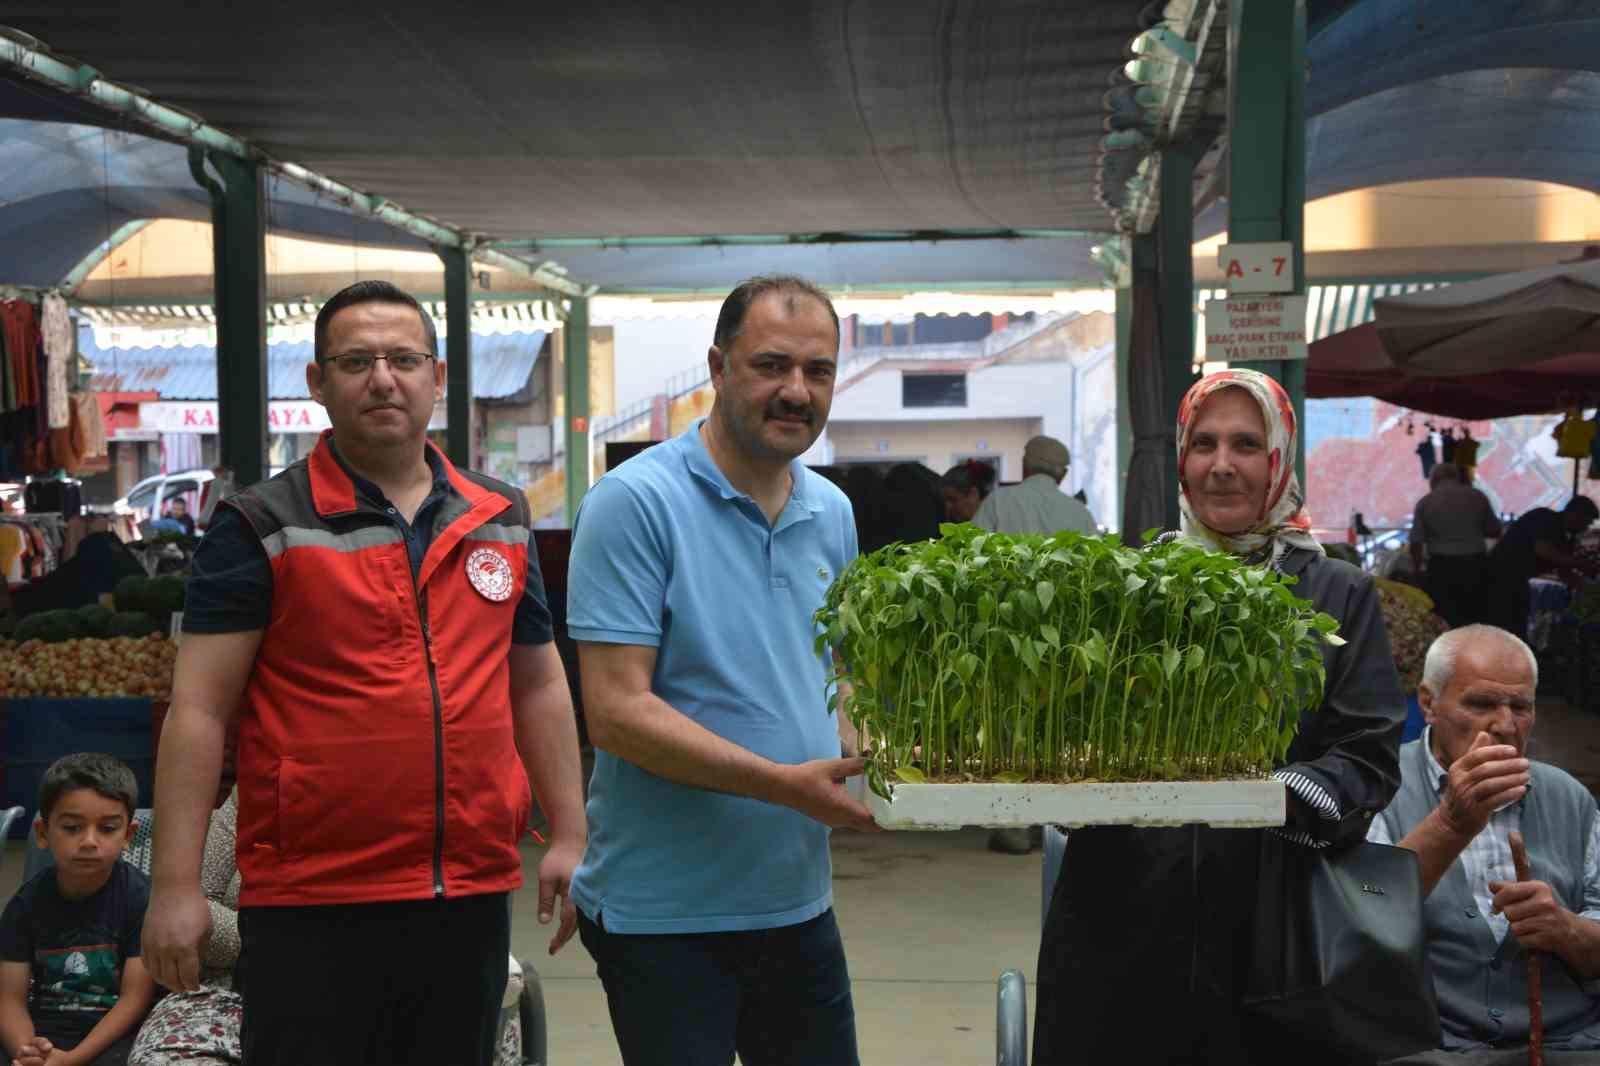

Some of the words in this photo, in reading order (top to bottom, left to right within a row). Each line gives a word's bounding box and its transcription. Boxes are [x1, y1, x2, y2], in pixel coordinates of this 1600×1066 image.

[1226, 258, 1244, 278] A
[1272, 256, 1287, 277] 7
[1238, 332, 1265, 343] PARK
